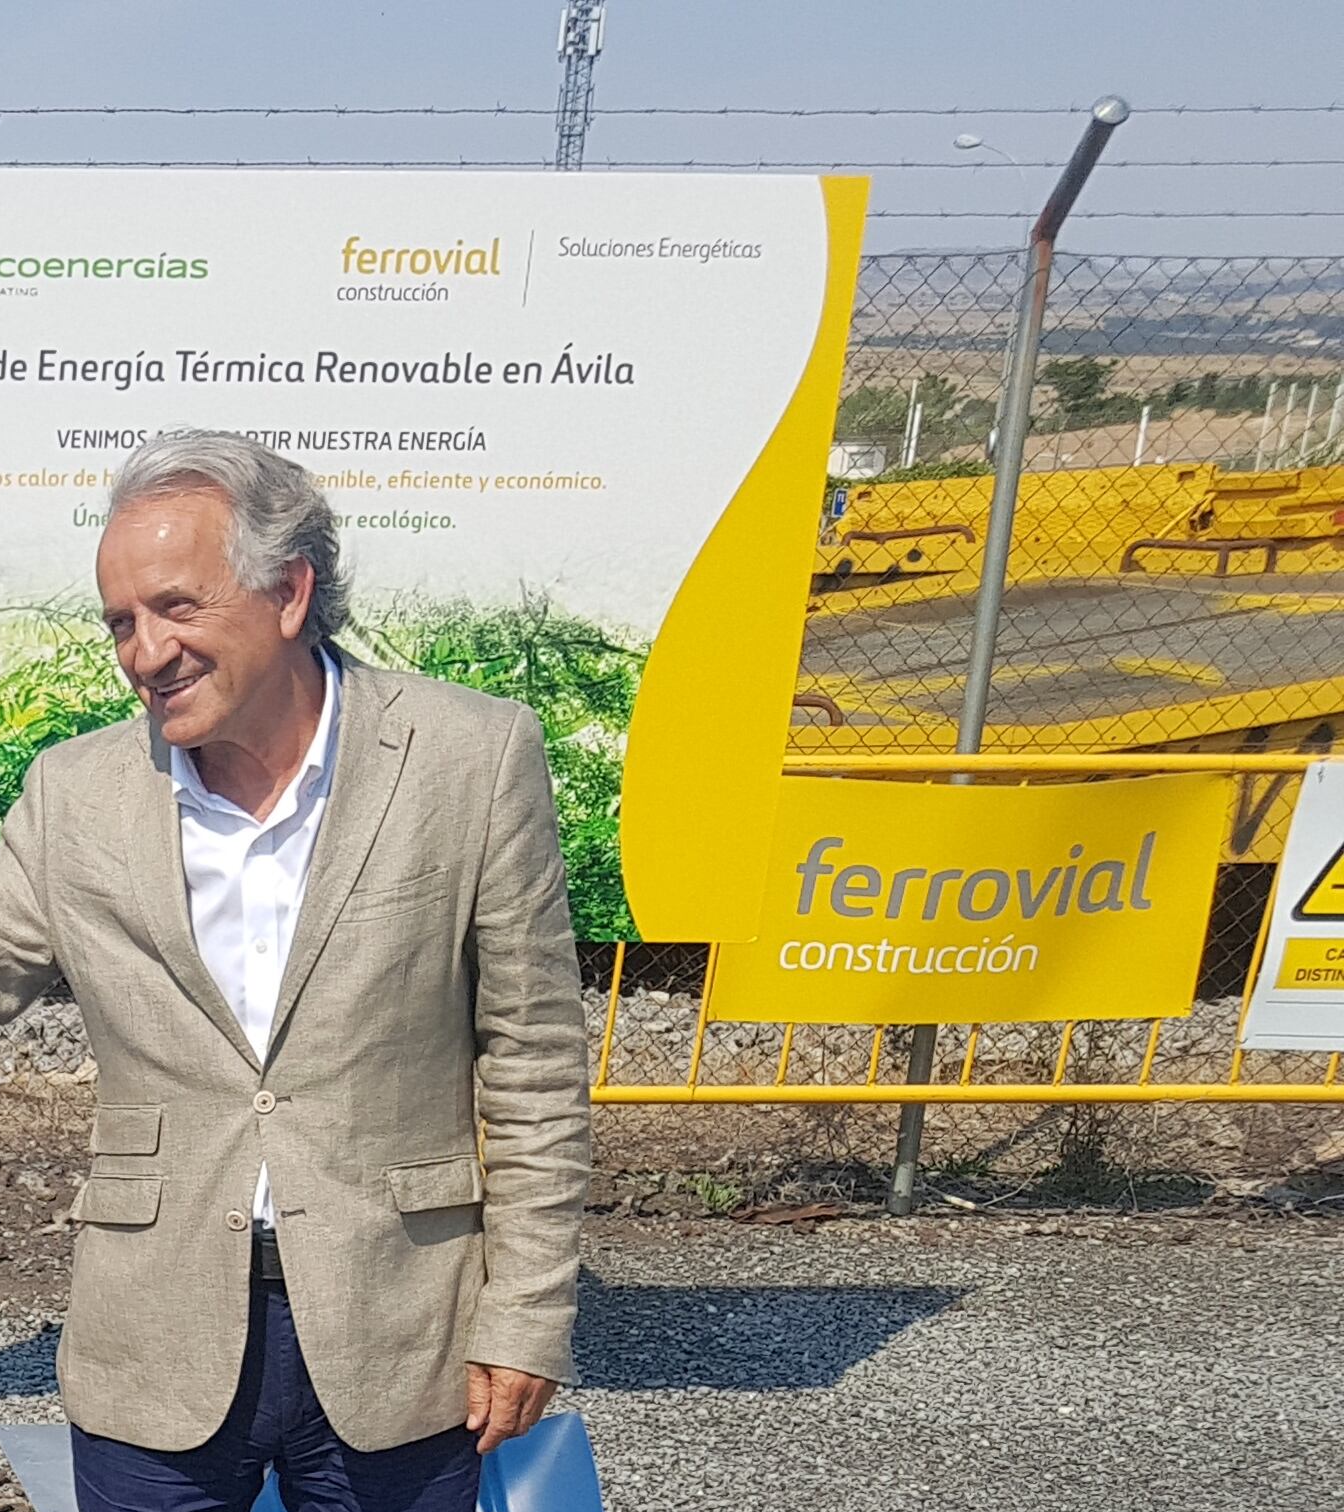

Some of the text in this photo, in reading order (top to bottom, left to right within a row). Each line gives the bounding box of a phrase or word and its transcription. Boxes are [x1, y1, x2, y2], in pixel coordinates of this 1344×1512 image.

[341, 236, 501, 275] ferrovial
[558, 236, 762, 263] Soluciones Energéticas
[336, 281, 449, 301] construcción
[38, 350, 165, 391] Energía
[176, 350, 305, 383] Térmica
[315, 352, 493, 384] Renovable
[502, 361, 543, 384] en
[551, 343, 634, 384] Ávila
[56, 429, 147, 449] VENIMOS
[296, 430, 393, 452] NUESTRA
[398, 426, 487, 452] ENERGÍA
[18, 467, 69, 487] calor
[73, 468, 98, 487] de
[314, 470, 607, 493] enible, eficiente y económico.
[357, 510, 457, 534] ecológico.
[795, 830, 1156, 922] ferrovial
[779, 932, 1040, 975] construcción
[1325, 947, 1344, 961] CA
[1295, 968, 1344, 982] DISTIN
